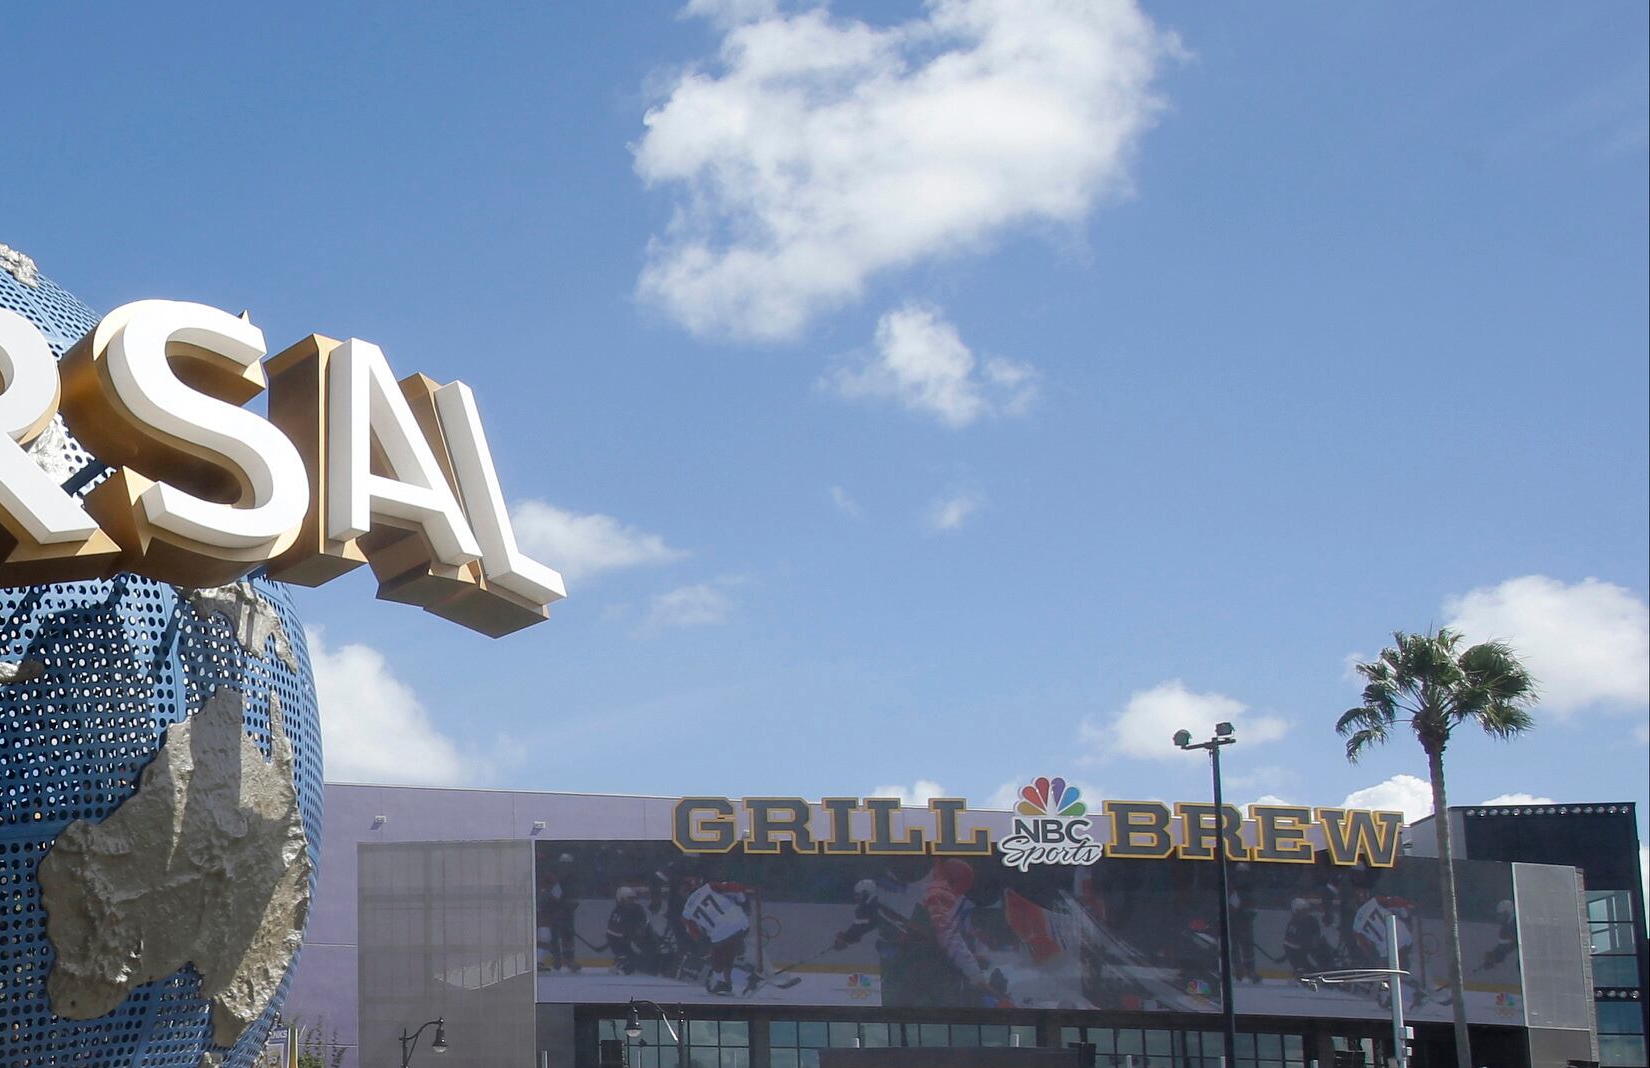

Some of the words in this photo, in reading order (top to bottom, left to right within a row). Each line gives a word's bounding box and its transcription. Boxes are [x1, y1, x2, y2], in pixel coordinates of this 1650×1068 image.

[672, 797, 992, 855] GRILL
[1102, 800, 1404, 867] BREW
[1014, 818, 1091, 844] NBC
[1000, 834, 1102, 870] Sports
[693, 894, 725, 928] 77
